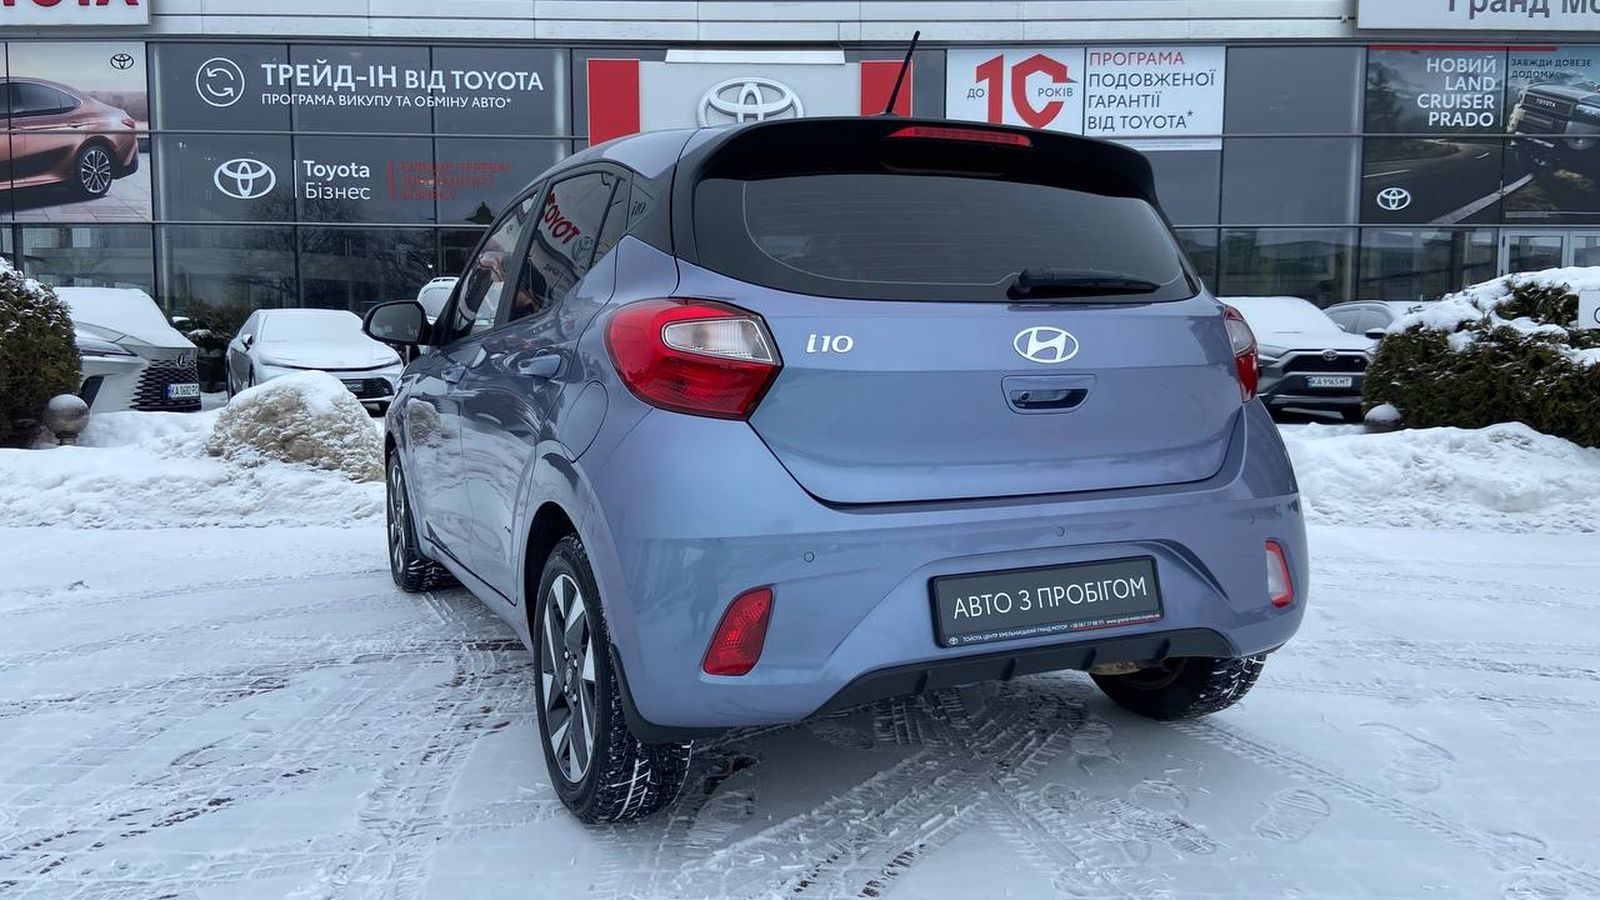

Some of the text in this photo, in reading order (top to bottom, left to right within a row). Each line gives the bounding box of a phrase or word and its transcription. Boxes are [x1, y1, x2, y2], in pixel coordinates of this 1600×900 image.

[1089, 52, 1185, 66] ПРОГРАМА
[1426, 55, 1497, 73] НОВИЙ
[1511, 58, 1593, 67] ЗАВЖДИ ДОВЕЗЕ
[261, 59, 544, 93] ТРЕЙД-ІН ВІД TOYOTA
[1089, 69, 1217, 90] ПОДОВЖЕНОЇ
[1445, 76, 1496, 91] LAND
[967, 54, 1074, 128] ДО 10 РОКІВ
[1088, 91, 1162, 108] ГАРАНТІЇ
[261, 93, 336, 106] ПРОГРАМА
[339, 95, 393, 107] ВИКУПУ
[395, 95, 412, 107] ТА
[414, 96, 469, 108] ОБМІНУ
[1417, 93, 1495, 109] CRUISER
[1087, 115, 1115, 132] ВІД
[1428, 111, 1494, 127] PRADO
[302, 160, 370, 181] Toyota
[305, 181, 371, 200] Бізнес
[805, 333, 854, 353] i10
[953, 592, 1012, 620] АВТО
[1037, 576, 1147, 609] ПРОБІГОМ
